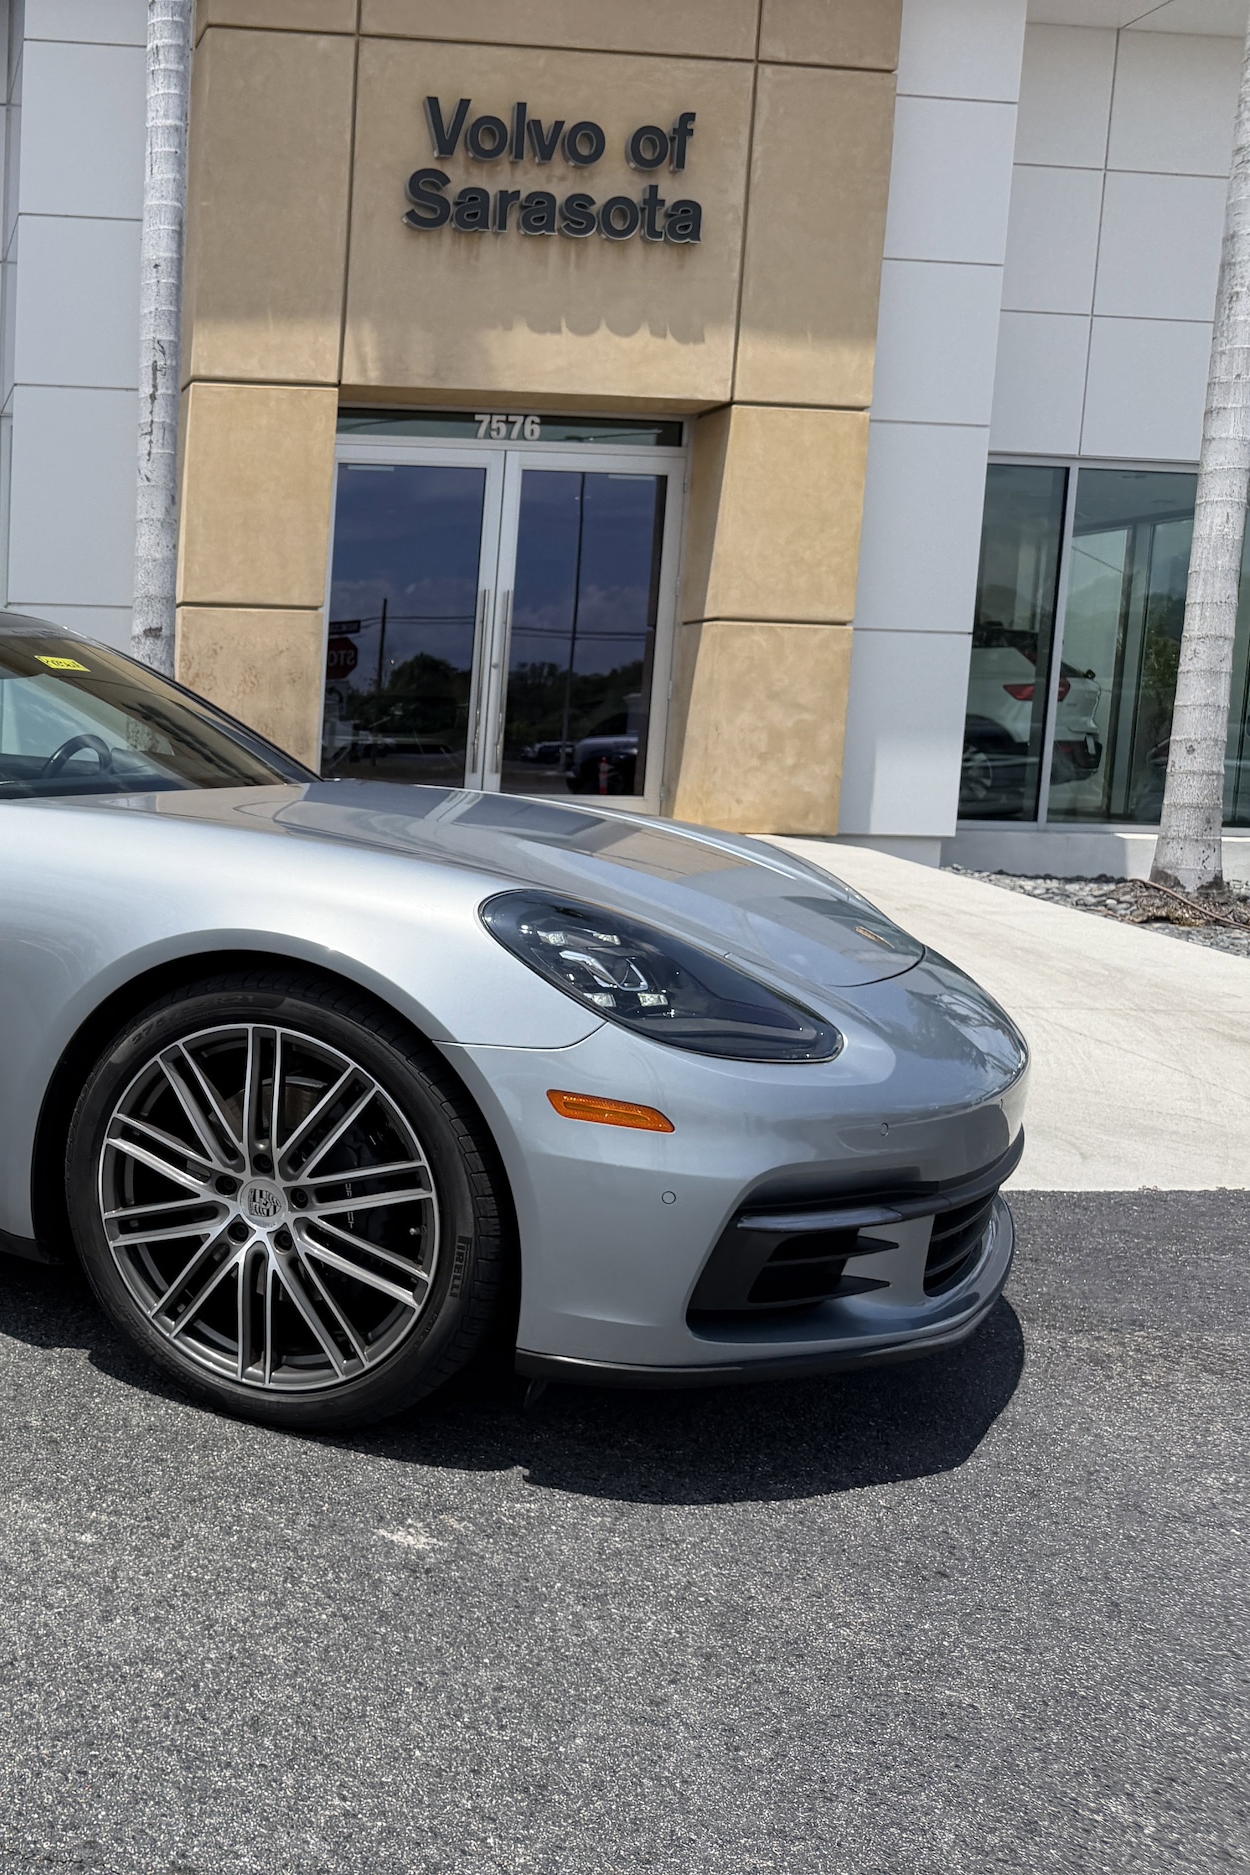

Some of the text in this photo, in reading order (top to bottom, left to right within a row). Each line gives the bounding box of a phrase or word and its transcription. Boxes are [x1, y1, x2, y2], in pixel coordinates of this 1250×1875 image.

[423, 96, 697, 173] Volvo of
[402, 168, 703, 244] Sarasota
[474, 414, 541, 440] 7576
[450, 1235, 473, 1299] PIRELLI
